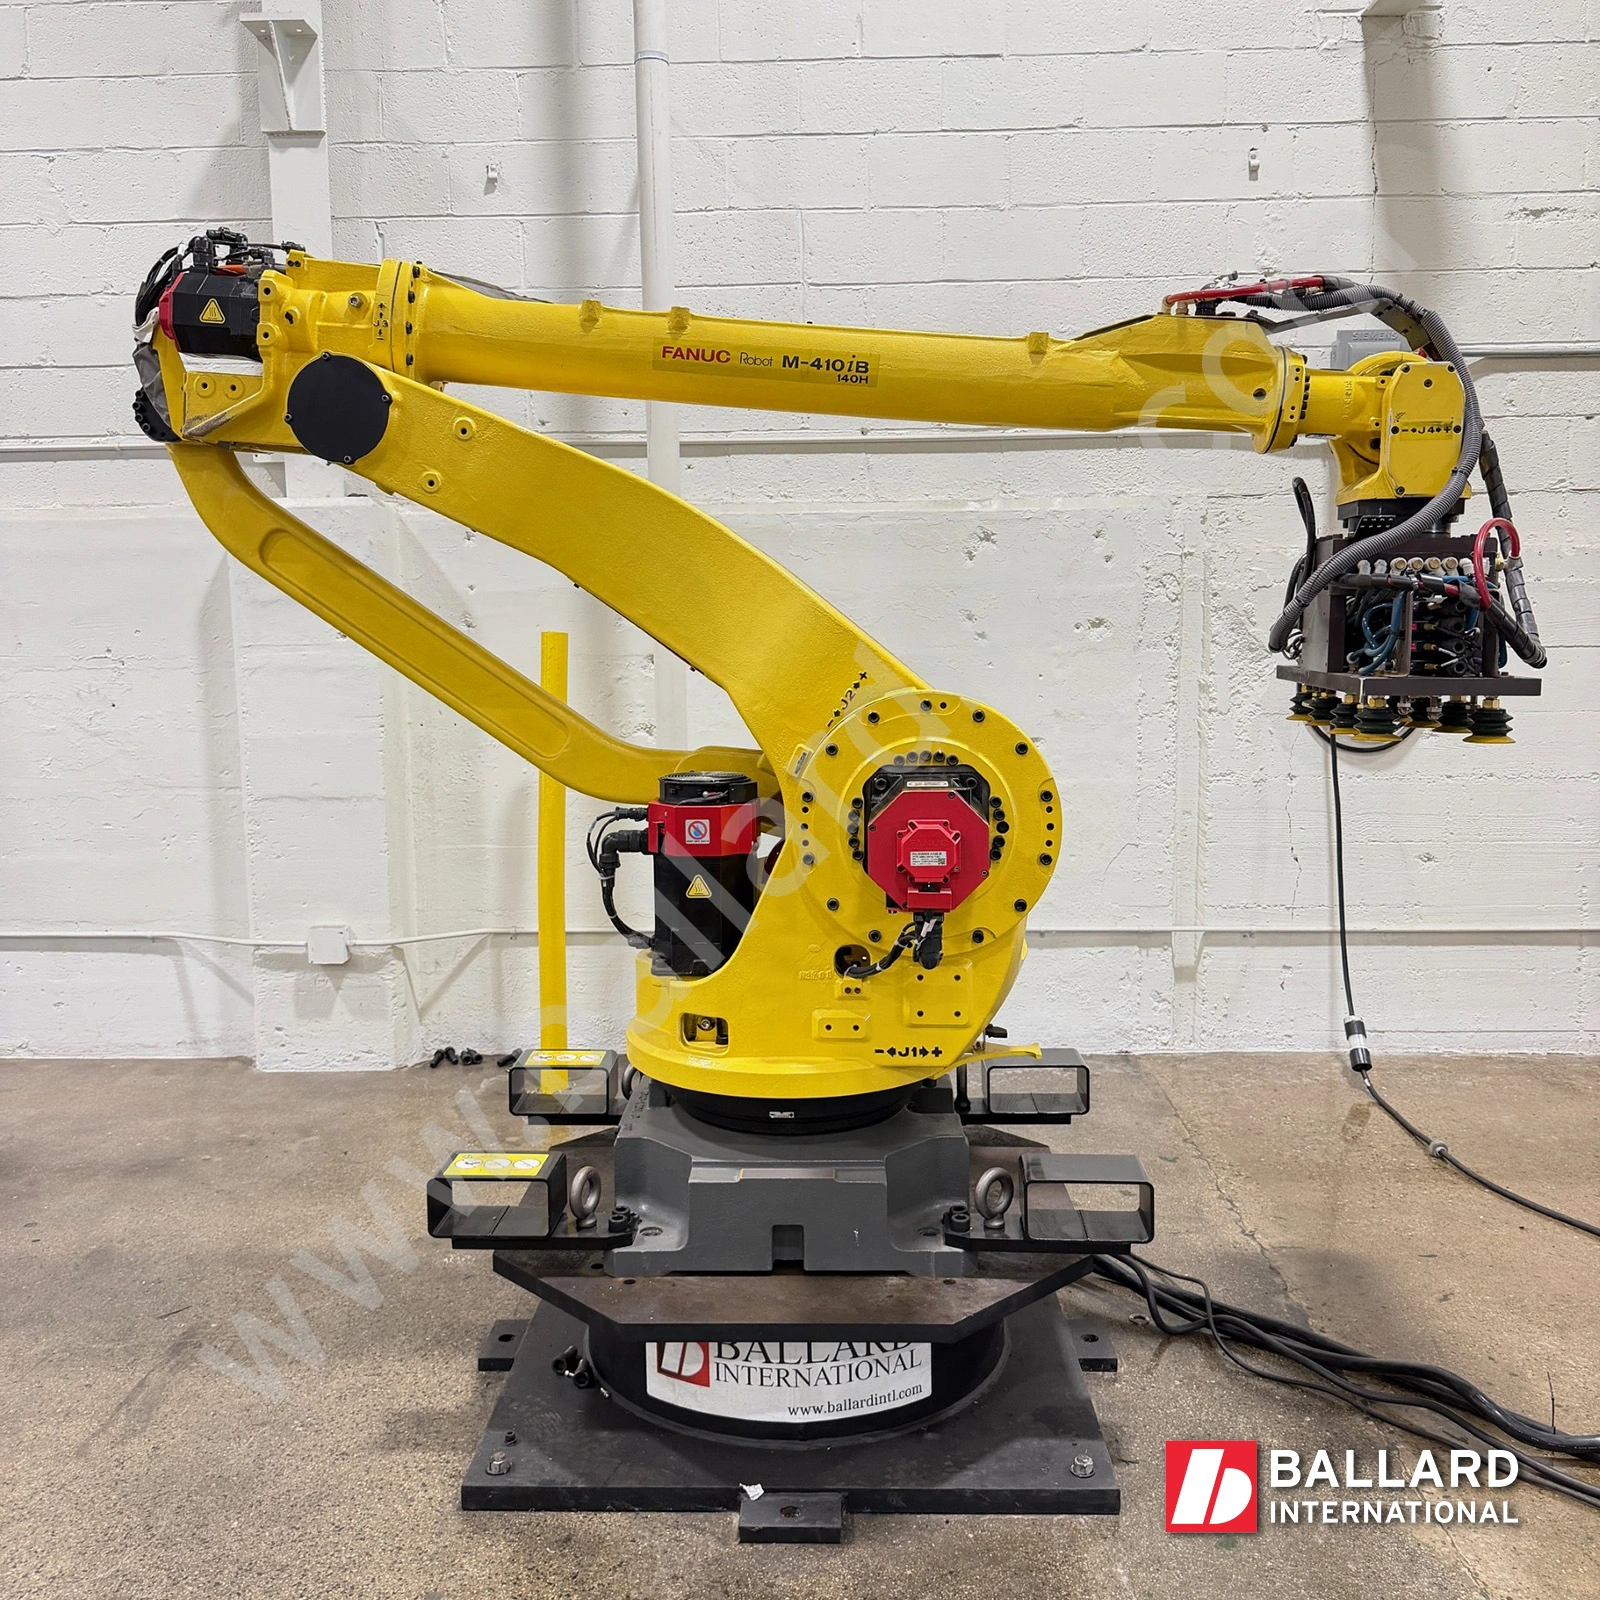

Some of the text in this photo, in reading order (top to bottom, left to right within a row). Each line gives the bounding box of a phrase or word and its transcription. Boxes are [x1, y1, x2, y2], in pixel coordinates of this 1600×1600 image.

[1353, 331, 1399, 341] SIEMENS
[661, 345, 870, 374] FANUC Robot M-410iB
[837, 374, 869, 384] 140H
[898, 1046, 918, 1058] J1
[714, 1341, 913, 1365] BALLA
[714, 1348, 923, 1388] INTERNATIONAL
[788, 1383, 923, 1416] www.ballardintl.com
